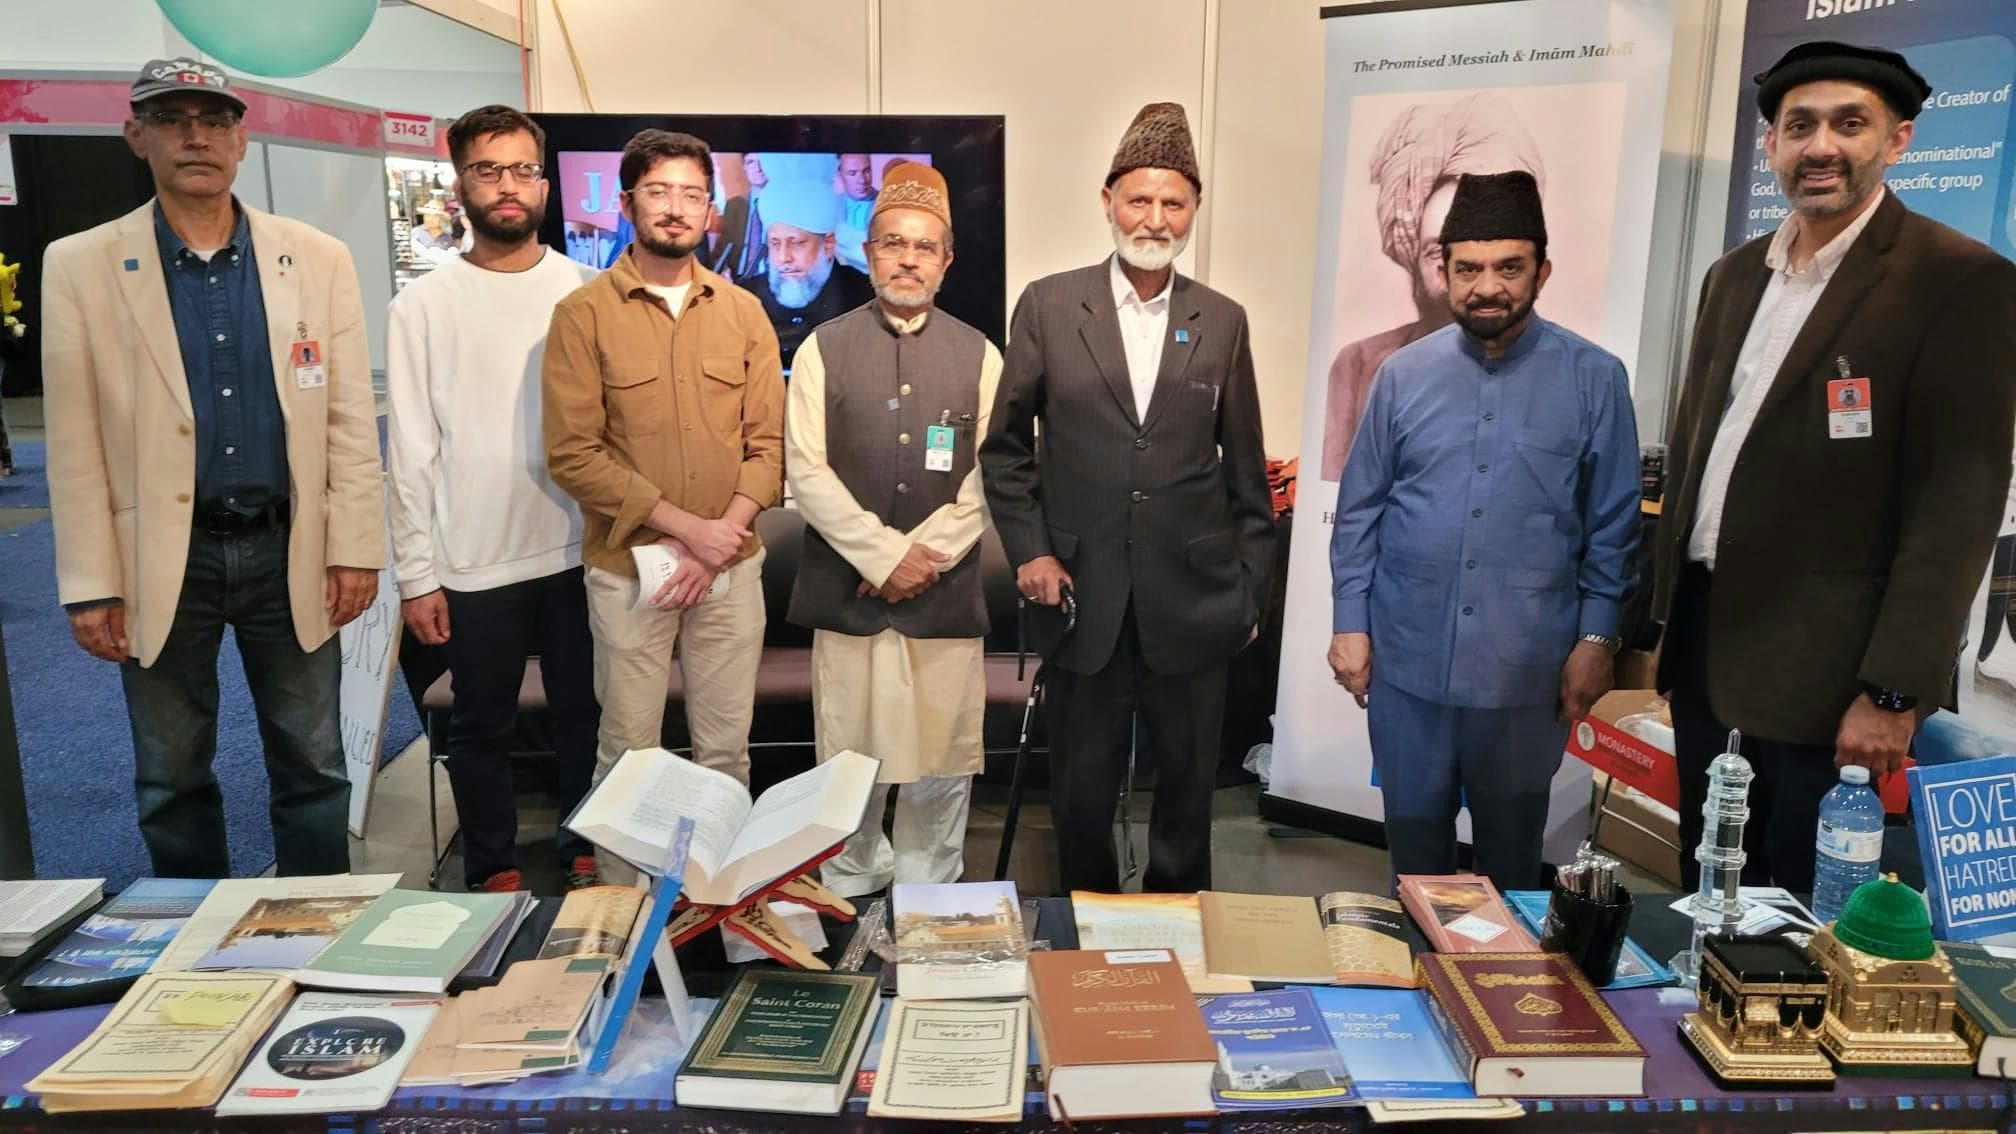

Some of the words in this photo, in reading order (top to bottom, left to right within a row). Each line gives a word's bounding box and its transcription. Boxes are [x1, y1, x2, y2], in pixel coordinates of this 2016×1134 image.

[1353, 60, 1376, 73] The
[1378, 54, 1445, 71] Promised
[1448, 50, 1509, 67] Messiah
[1512, 50, 1526, 62] &
[1529, 47, 1575, 62] Imām
[151, 61, 225, 88] CANADA
[1936, 88, 1989, 108] Creator
[1992, 83, 2012, 102] of
[391, 122, 428, 137] 3142
[1887, 172, 1936, 191] specific
[1938, 174, 1984, 193] group
[1749, 209, 1760, 219] or
[1761, 204, 1788, 220] tribe
[1597, 731, 1656, 770] MONASTERY
[1931, 782, 2016, 832] LOVE
[1940, 831, 1982, 857] FOR
[1986, 826, 2016, 850] ALL
[1951, 894, 1985, 915] FOR
[751, 996, 792, 1007] Saint
[793, 999, 842, 1010] Coran
[792, 988, 811, 998] Le
[287, 1045, 382, 1055] ISLAM
